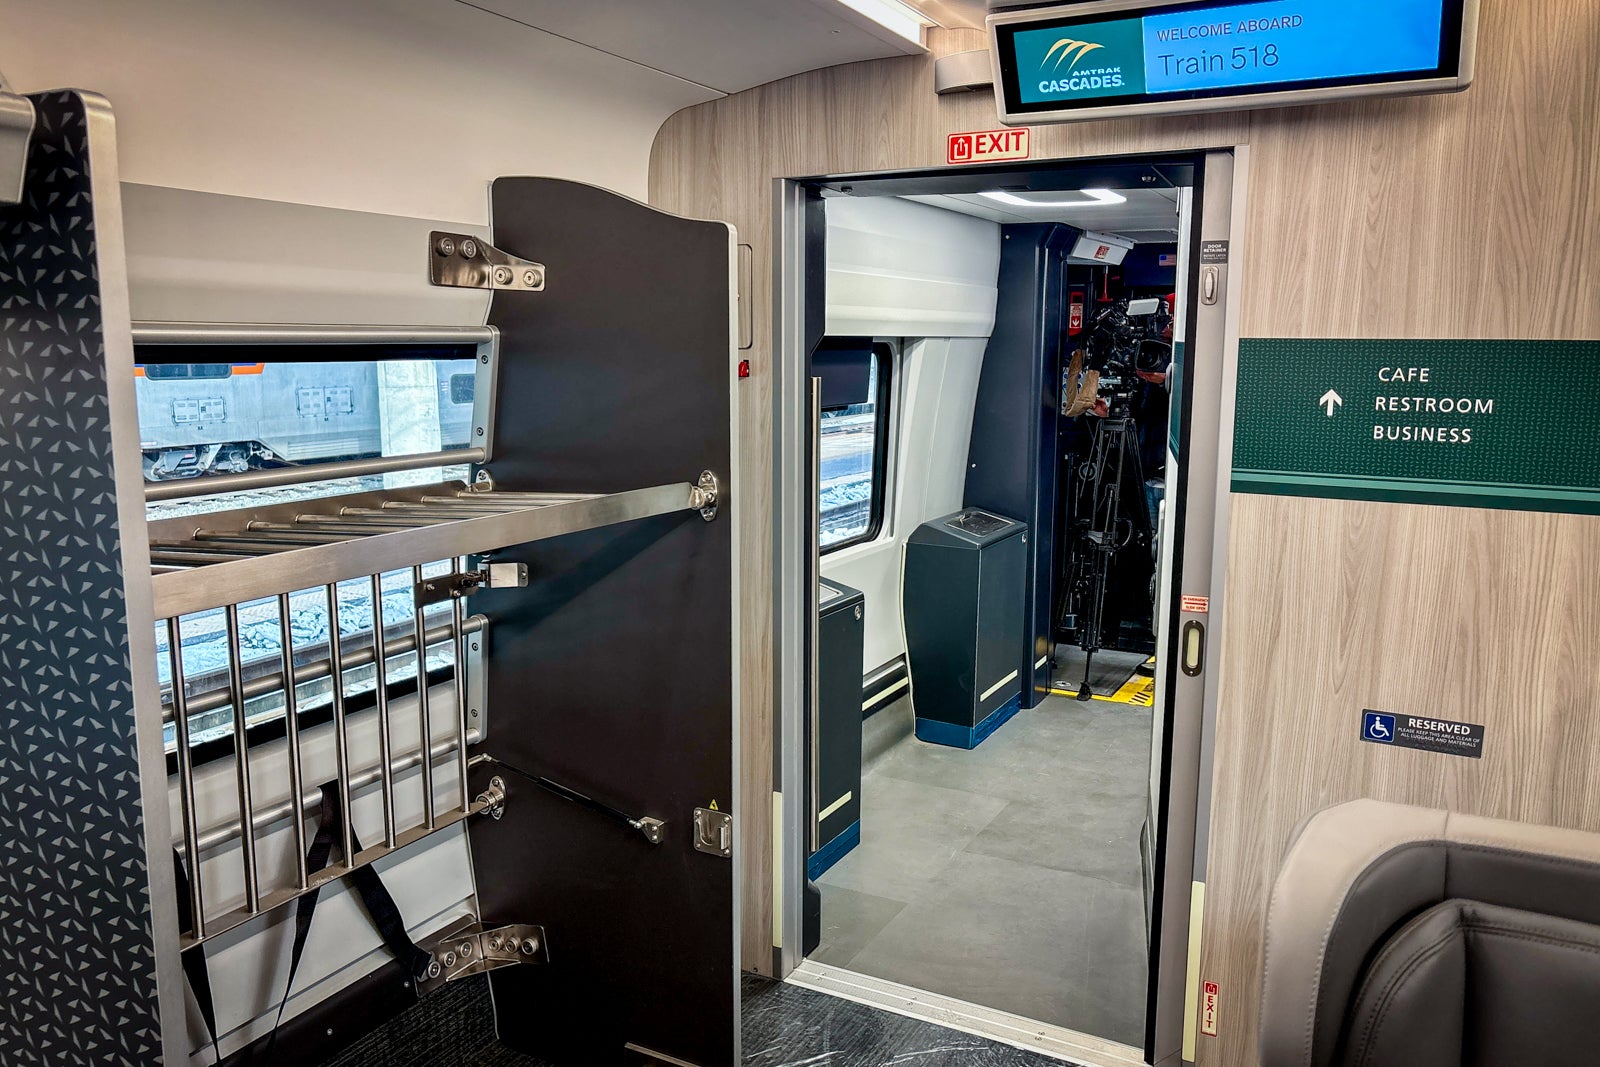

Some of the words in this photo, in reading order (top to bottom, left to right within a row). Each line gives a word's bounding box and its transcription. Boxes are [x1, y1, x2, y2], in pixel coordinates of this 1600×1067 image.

[1157, 22, 1232, 42] WELCOME
[1237, 15, 1303, 33] ABOARD
[1158, 49, 1224, 76] Train
[1231, 43, 1279, 70] 518
[1072, 67, 1121, 77] AMTRAK
[975, 131, 1025, 154] EXIT
[1378, 367, 1430, 383] CAFE
[1375, 397, 1494, 414] RESTROOM
[1373, 425, 1472, 443] BUSINESS
[1408, 718, 1471, 735] RESERVED
[1448, 739, 1476, 748] MATERIALS
[1206, 995, 1214, 1029] EXIT
